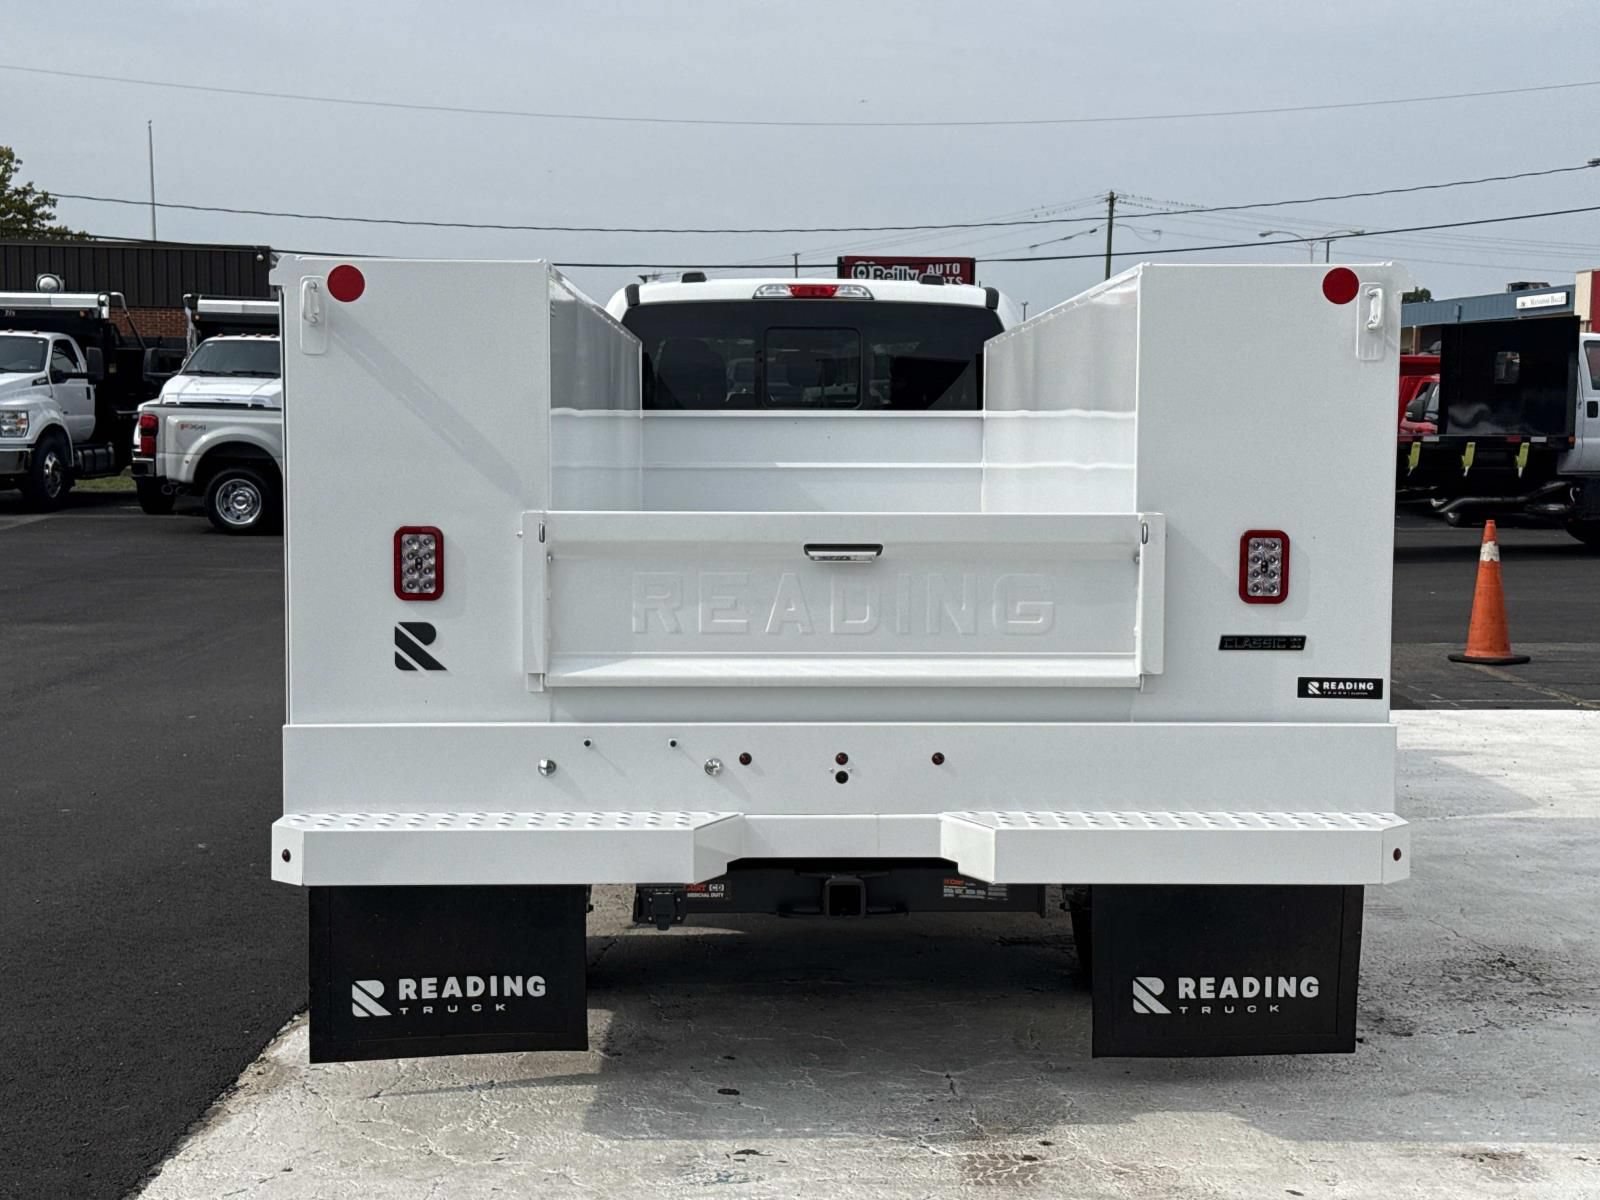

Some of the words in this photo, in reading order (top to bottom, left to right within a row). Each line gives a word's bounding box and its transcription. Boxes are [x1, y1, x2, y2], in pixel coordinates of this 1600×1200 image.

[926, 263, 961, 275] AUTO
[631, 571, 1057, 636] READING
[1222, 637, 1287, 649] CLASSIC
[1323, 681, 1374, 690] READING
[398, 975, 546, 1000] READING
[1178, 976, 1319, 999] READING
[400, 1003, 506, 1015] TRUCK
[1179, 1004, 1279, 1014] TRUCK
